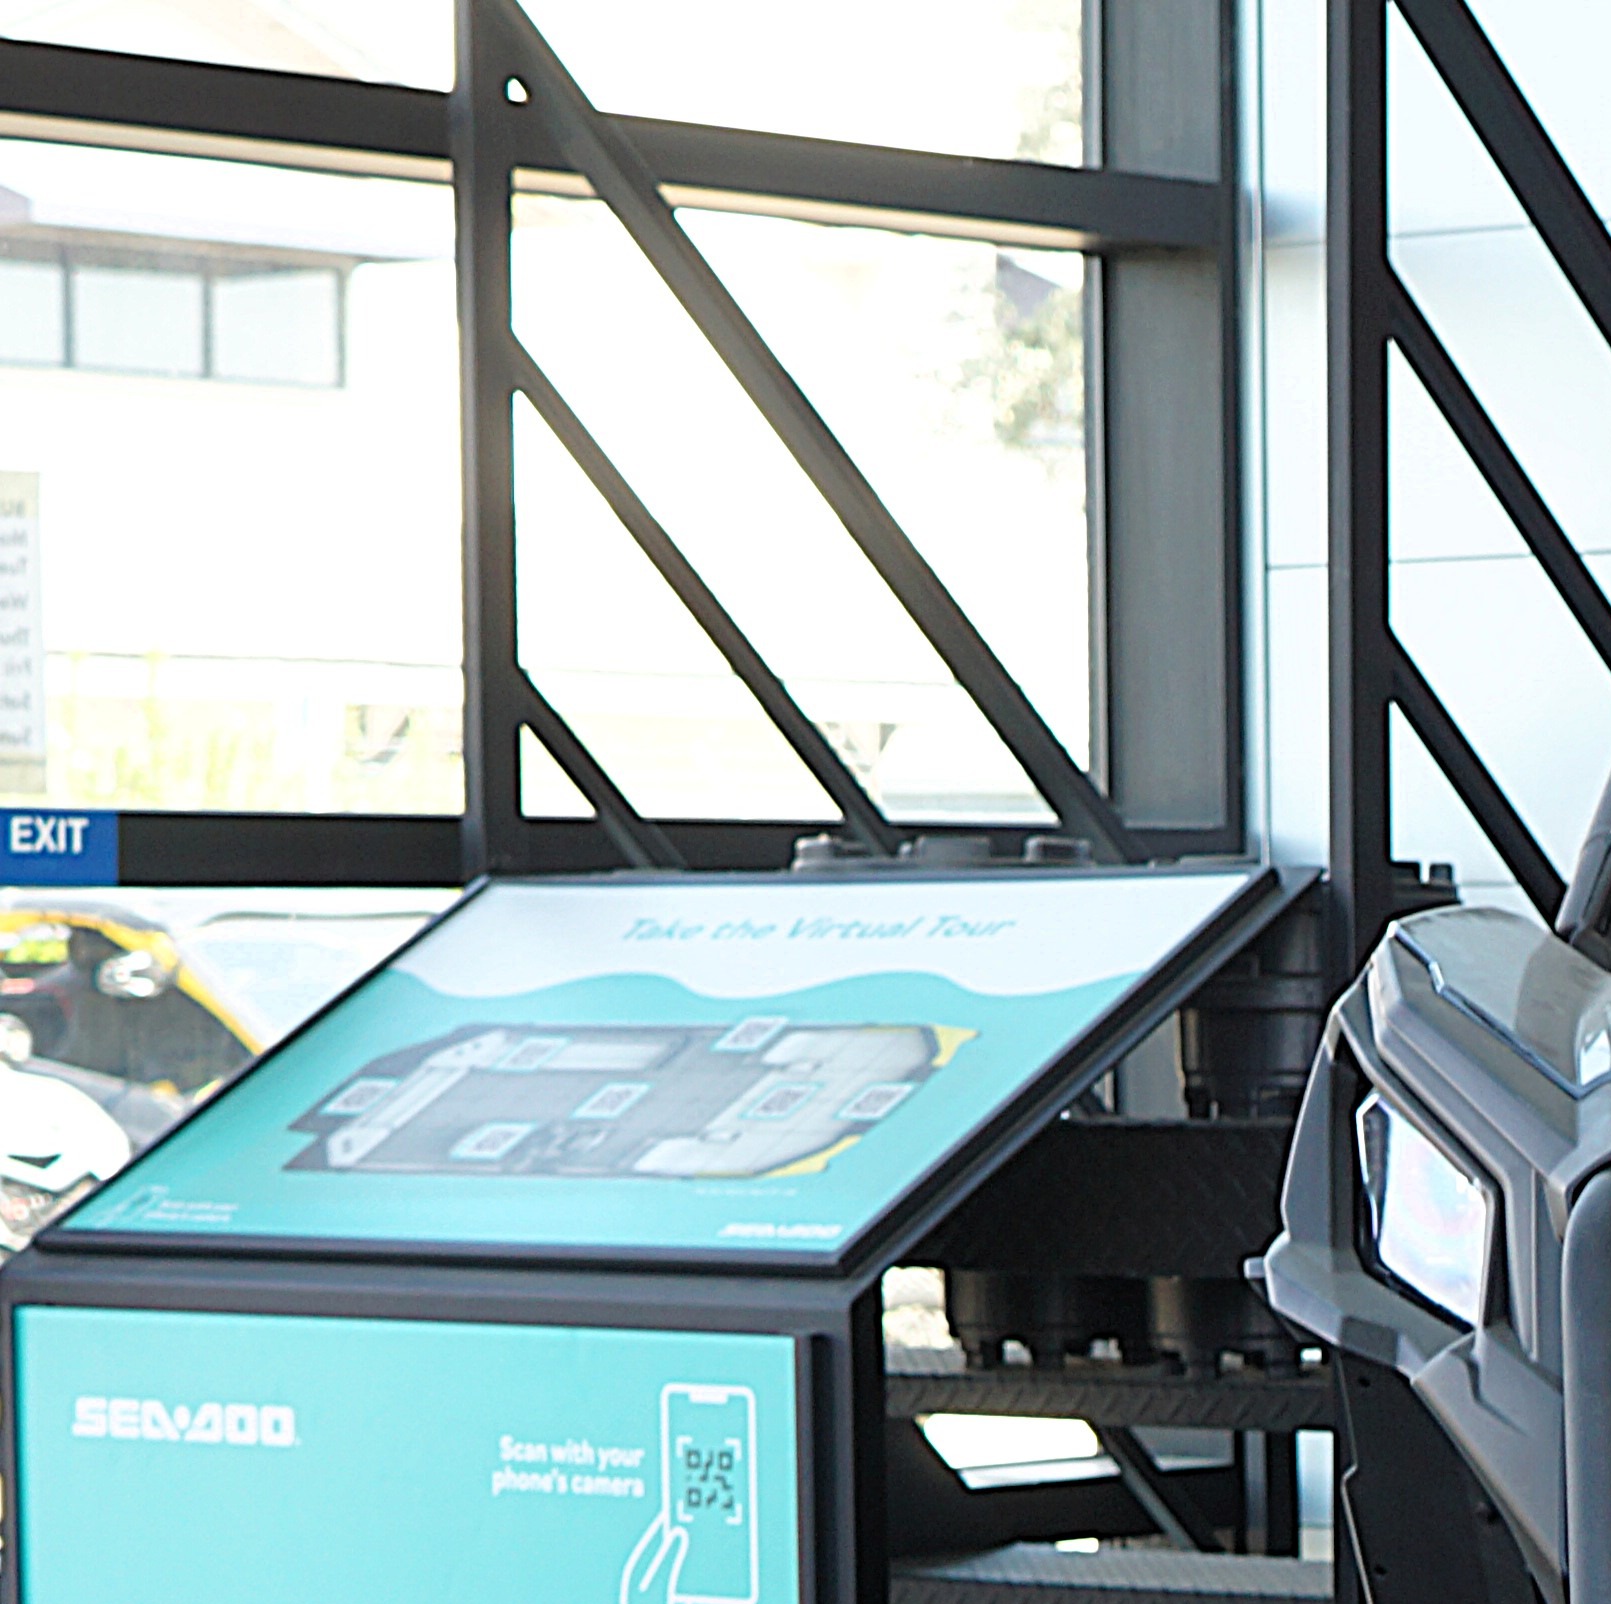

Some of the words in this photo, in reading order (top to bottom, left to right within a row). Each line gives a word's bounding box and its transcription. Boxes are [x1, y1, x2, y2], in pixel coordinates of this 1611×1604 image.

[11, 816, 89, 854] EXIT
[623, 917, 704, 940] Take
[709, 917, 777, 940] the
[787, 916, 924, 939] Virtual
[927, 915, 1018, 938] Tour
[499, 1434, 547, 1462] Scan
[551, 1438, 595, 1465] with
[598, 1447, 645, 1472] your
[492, 1465, 567, 1496] phone's
[571, 1474, 645, 1498] camera
